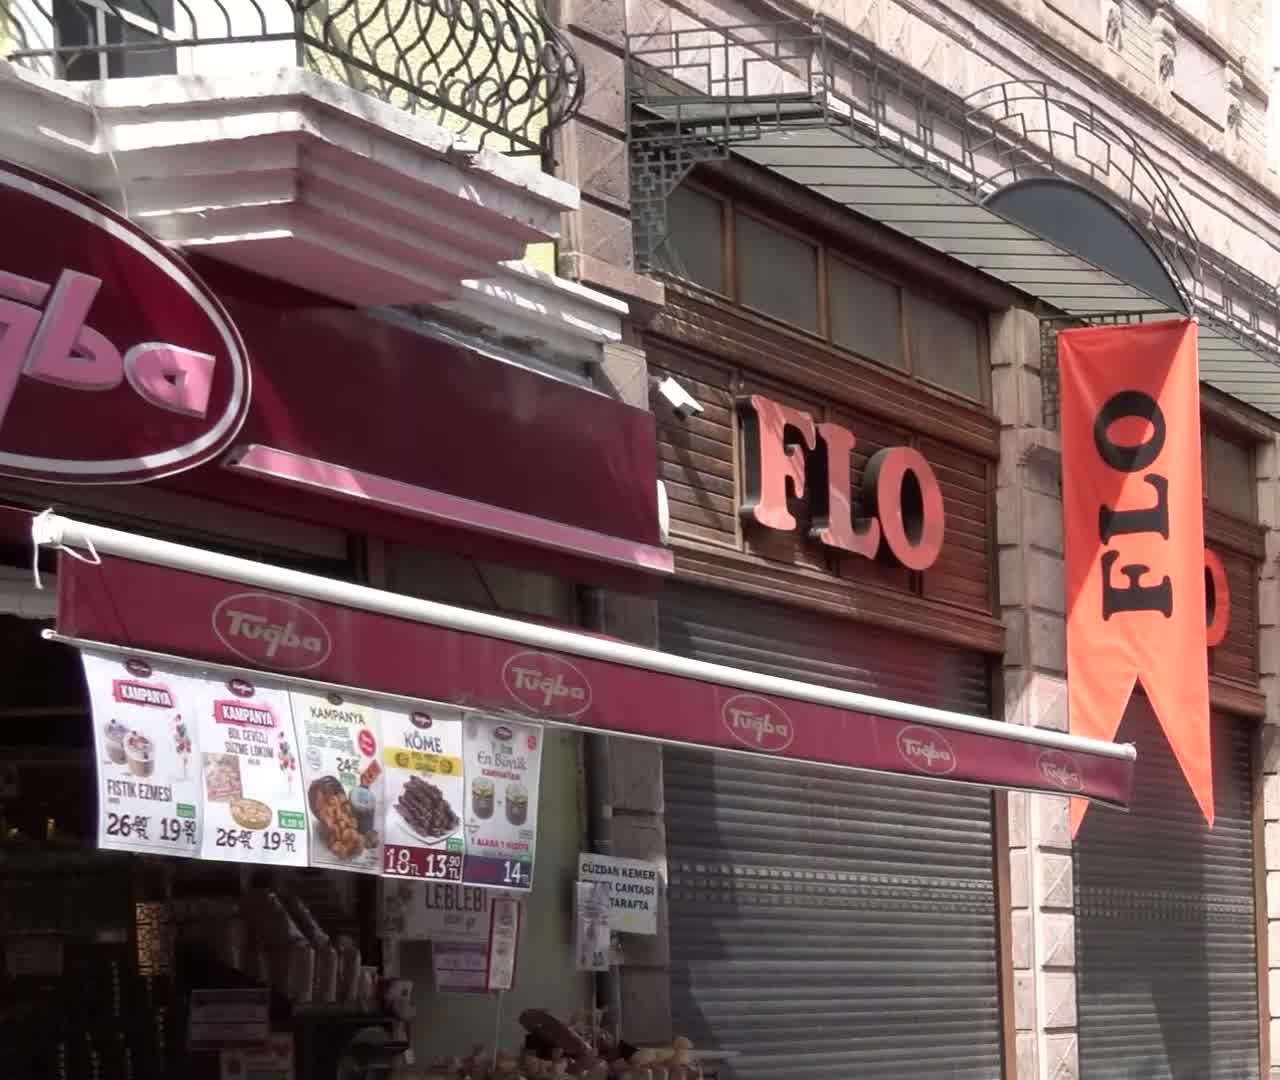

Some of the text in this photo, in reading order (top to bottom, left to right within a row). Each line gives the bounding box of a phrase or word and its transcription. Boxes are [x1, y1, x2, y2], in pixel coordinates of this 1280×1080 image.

[740, 394, 945, 571] FLO
[1093, 389, 1174, 622] FLO
[222, 705, 274, 725] KAMPANYA
[310, 706, 366, 725] KAMPANYA
[404, 729, 442, 753] KÖME
[582, 861, 656, 881] CÜZDAN KEMER
[609, 897, 649, 911] TARAFTA
